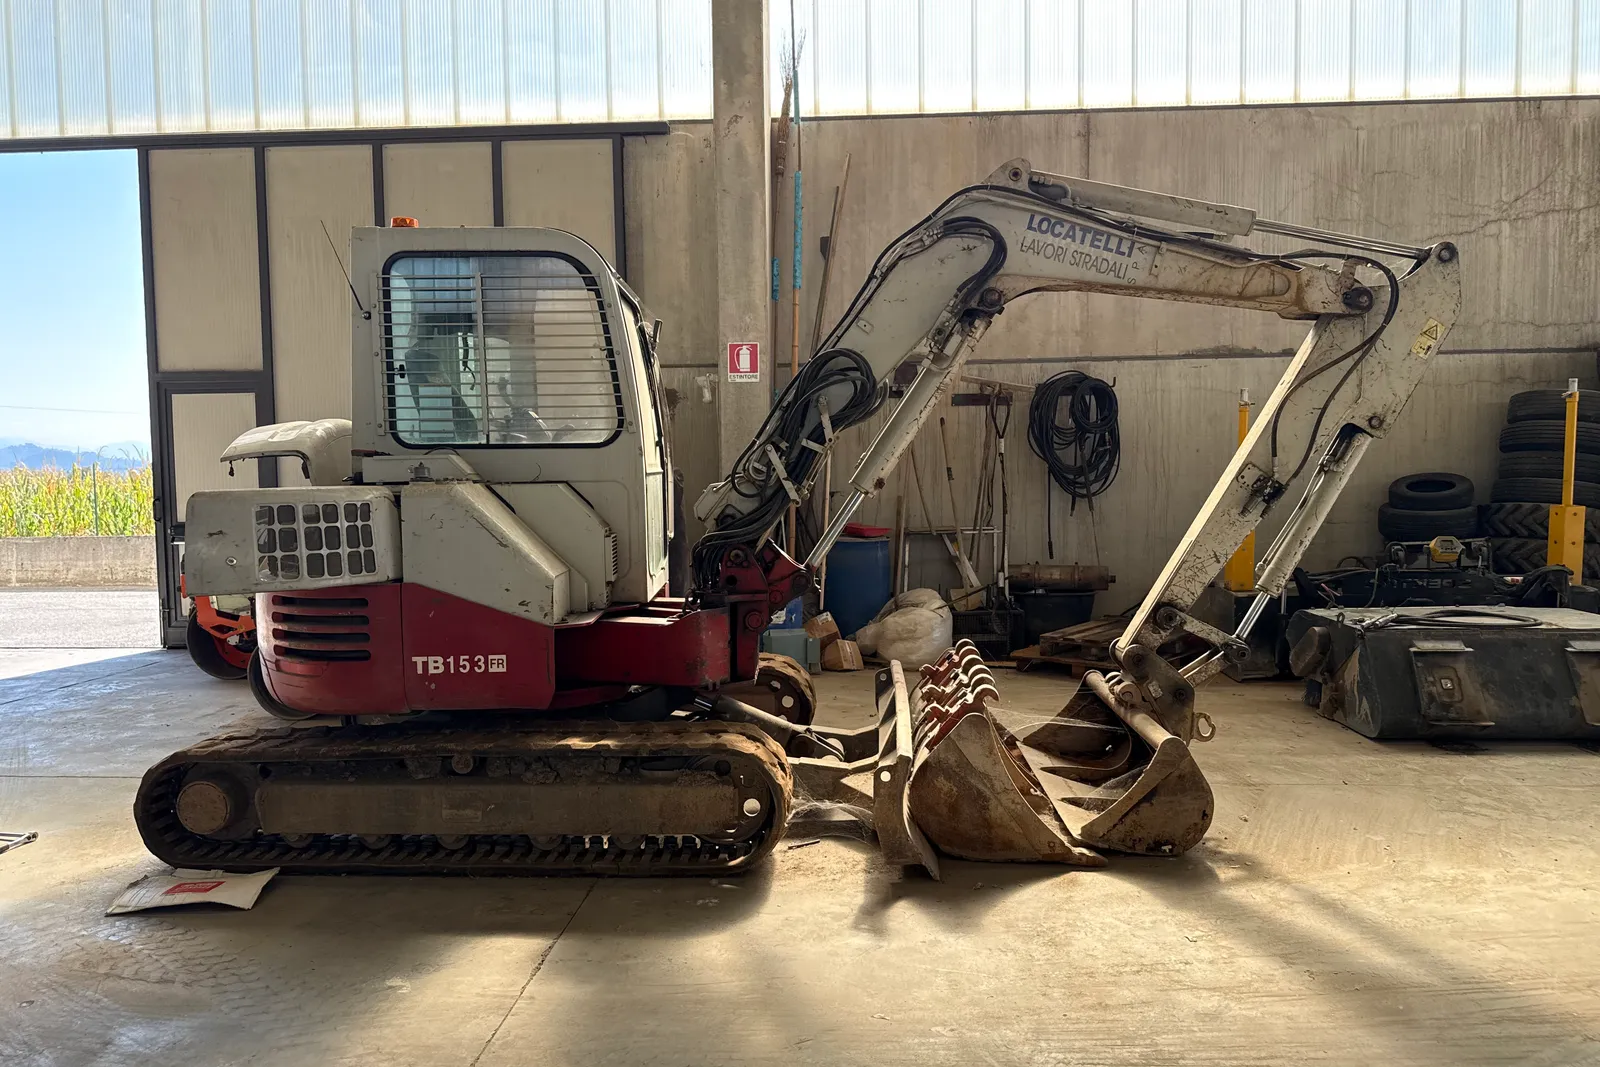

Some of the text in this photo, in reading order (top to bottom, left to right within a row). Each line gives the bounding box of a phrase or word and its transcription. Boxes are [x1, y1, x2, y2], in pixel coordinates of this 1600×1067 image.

[1020, 236, 1129, 280] LAVORI STRADALI
[1026, 213, 1136, 259] LOCATELLI
